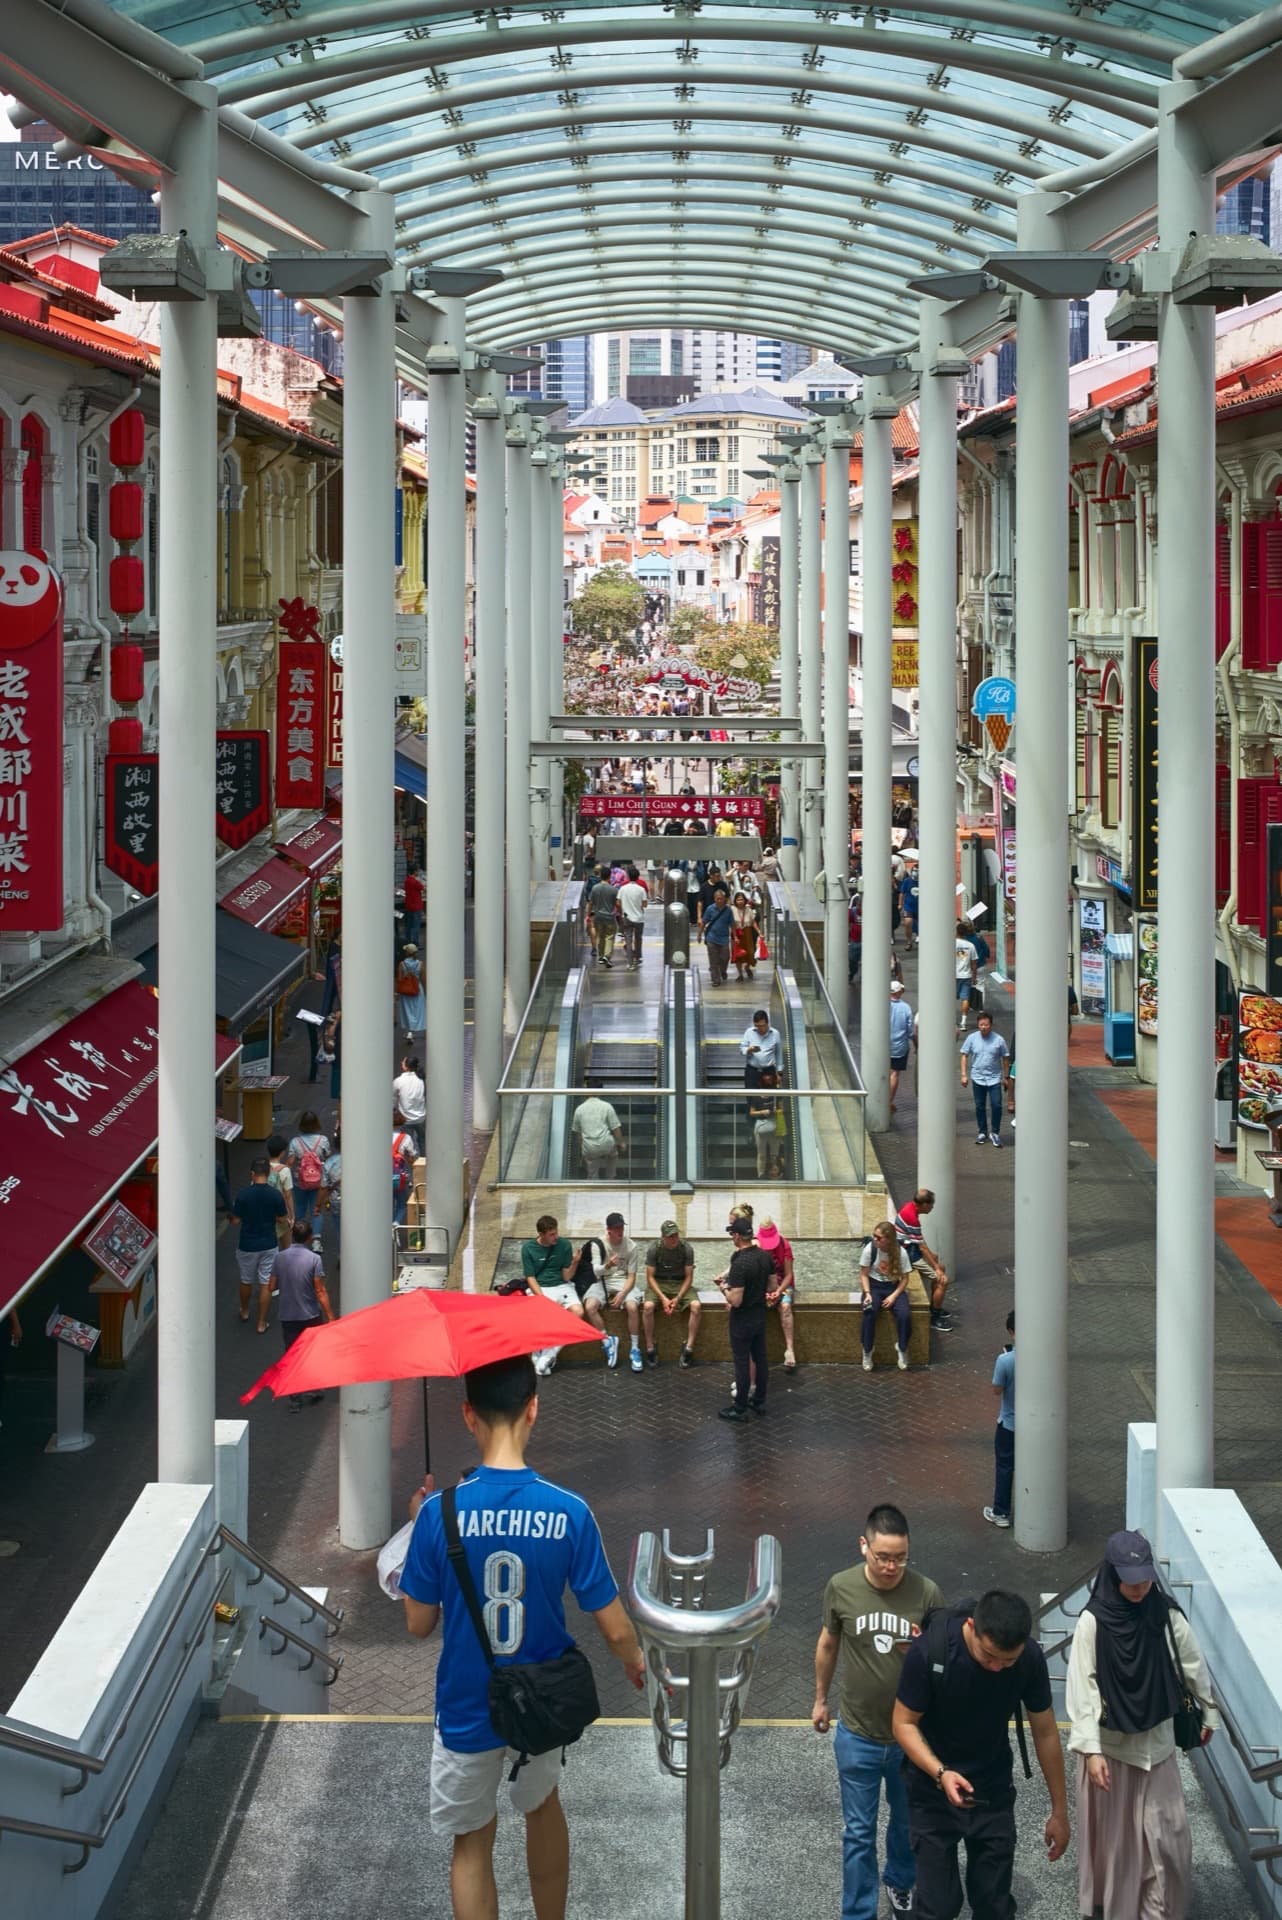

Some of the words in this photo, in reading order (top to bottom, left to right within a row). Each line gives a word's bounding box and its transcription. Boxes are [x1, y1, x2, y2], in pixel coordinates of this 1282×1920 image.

[287, 667, 315, 782] 东方美食
[123, 766, 152, 854] 湘西故里
[482, 1550, 525, 1656] 8
[855, 1611, 911, 1636] PUMA
